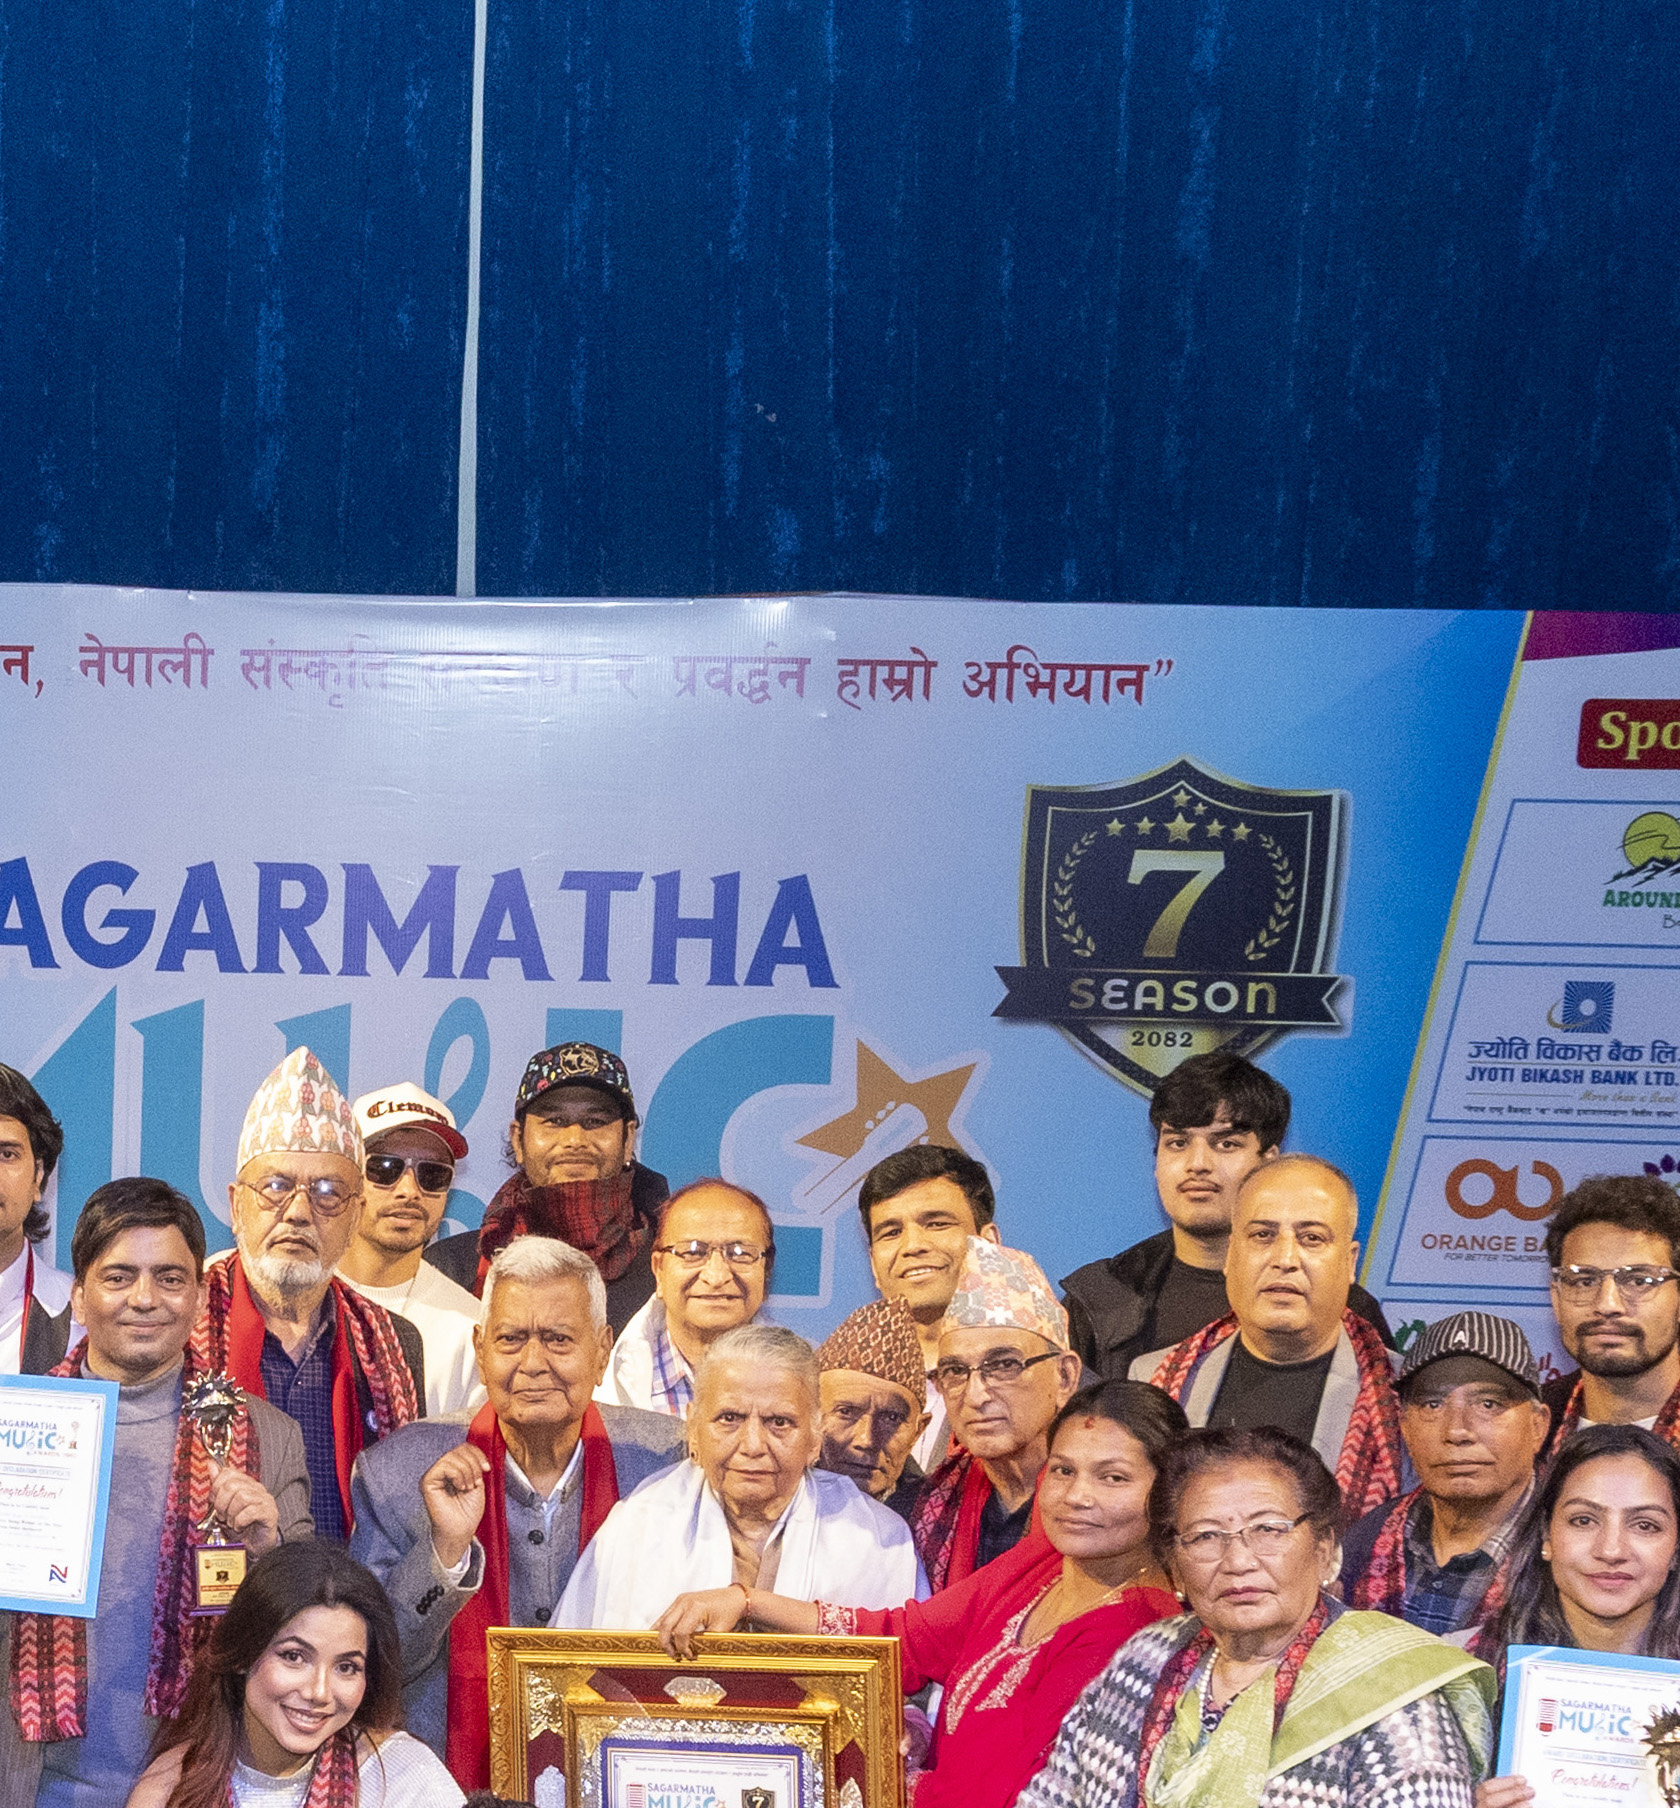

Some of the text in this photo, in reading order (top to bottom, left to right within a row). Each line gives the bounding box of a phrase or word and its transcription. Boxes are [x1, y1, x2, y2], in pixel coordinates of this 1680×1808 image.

[79, 630, 215, 689] नेपाली
[837, 646, 937, 710] हाम्रो
[1126, 849, 1225, 958] 7
[1069, 977, 1277, 1014] SEASON
[1130, 1029, 1194, 1048] 2082
[1468, 1036, 1530, 1060] ज्योति
[1536, 1037, 1603, 1062] विकास
[1466, 1066, 1679, 1086] JYOTI BIKASH BANK LTD.
[1421, 1233, 1517, 1252] ORANGE
[1444, 1252, 1551, 1264] FOR BETTER TOMORRO
[1453, 1330, 1467, 1344] A
[1560, 1698, 1632, 1714] SAGARMATHA
[647, 1782, 716, 1795] SAGARMATHA
